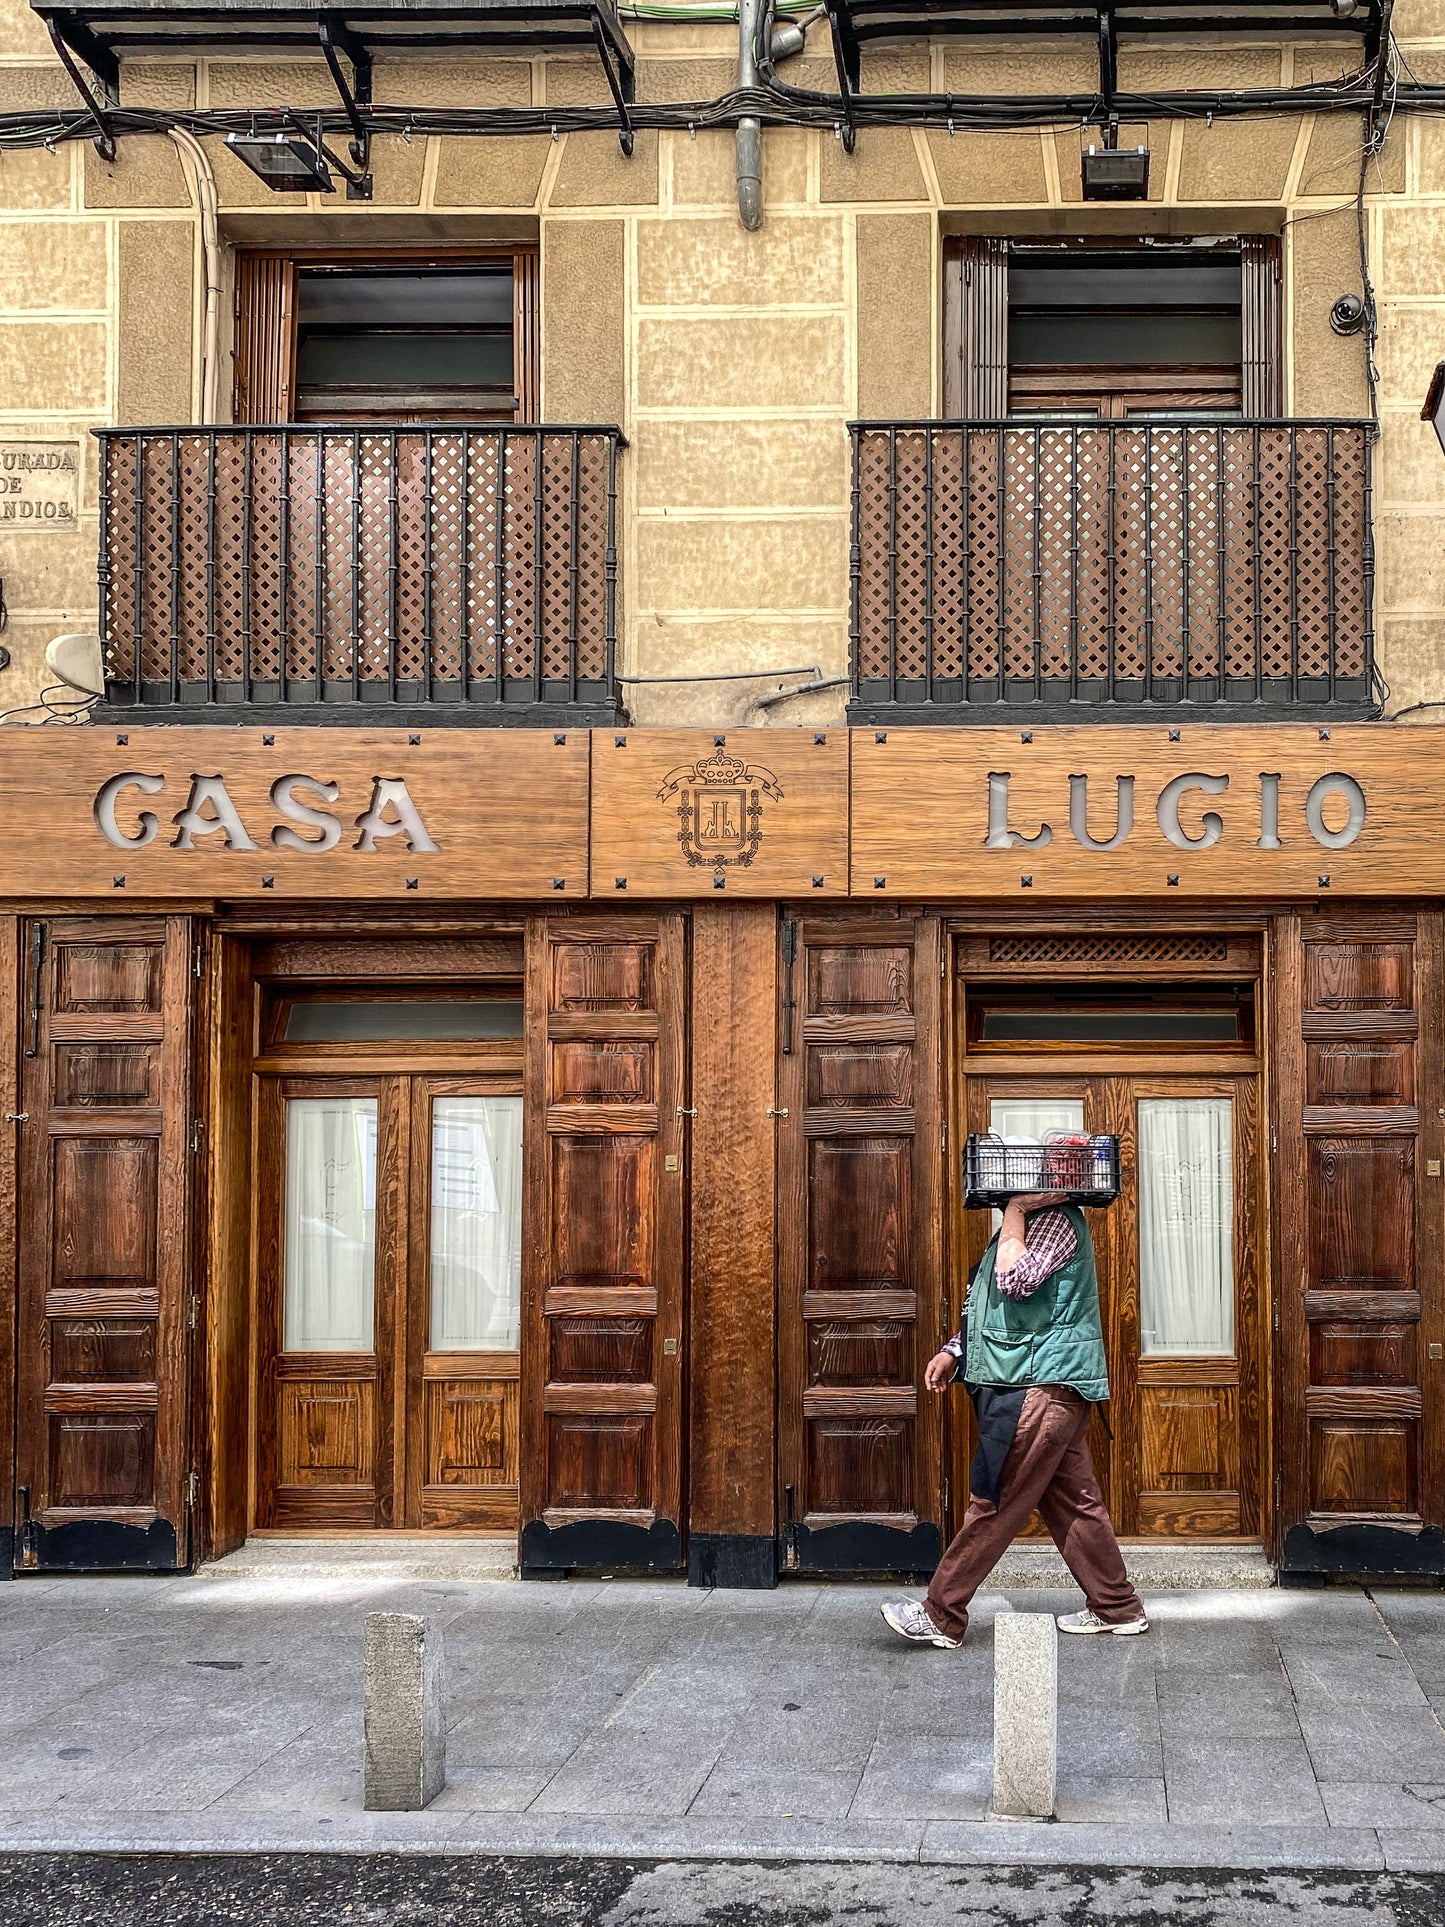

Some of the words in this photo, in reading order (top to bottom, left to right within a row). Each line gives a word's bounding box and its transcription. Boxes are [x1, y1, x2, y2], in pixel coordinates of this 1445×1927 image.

[0, 453, 75, 470] URADA
[0, 501, 72, 519] NDIOS
[93, 771, 442, 853] CASA
[984, 771, 1367, 851] LUCIO
